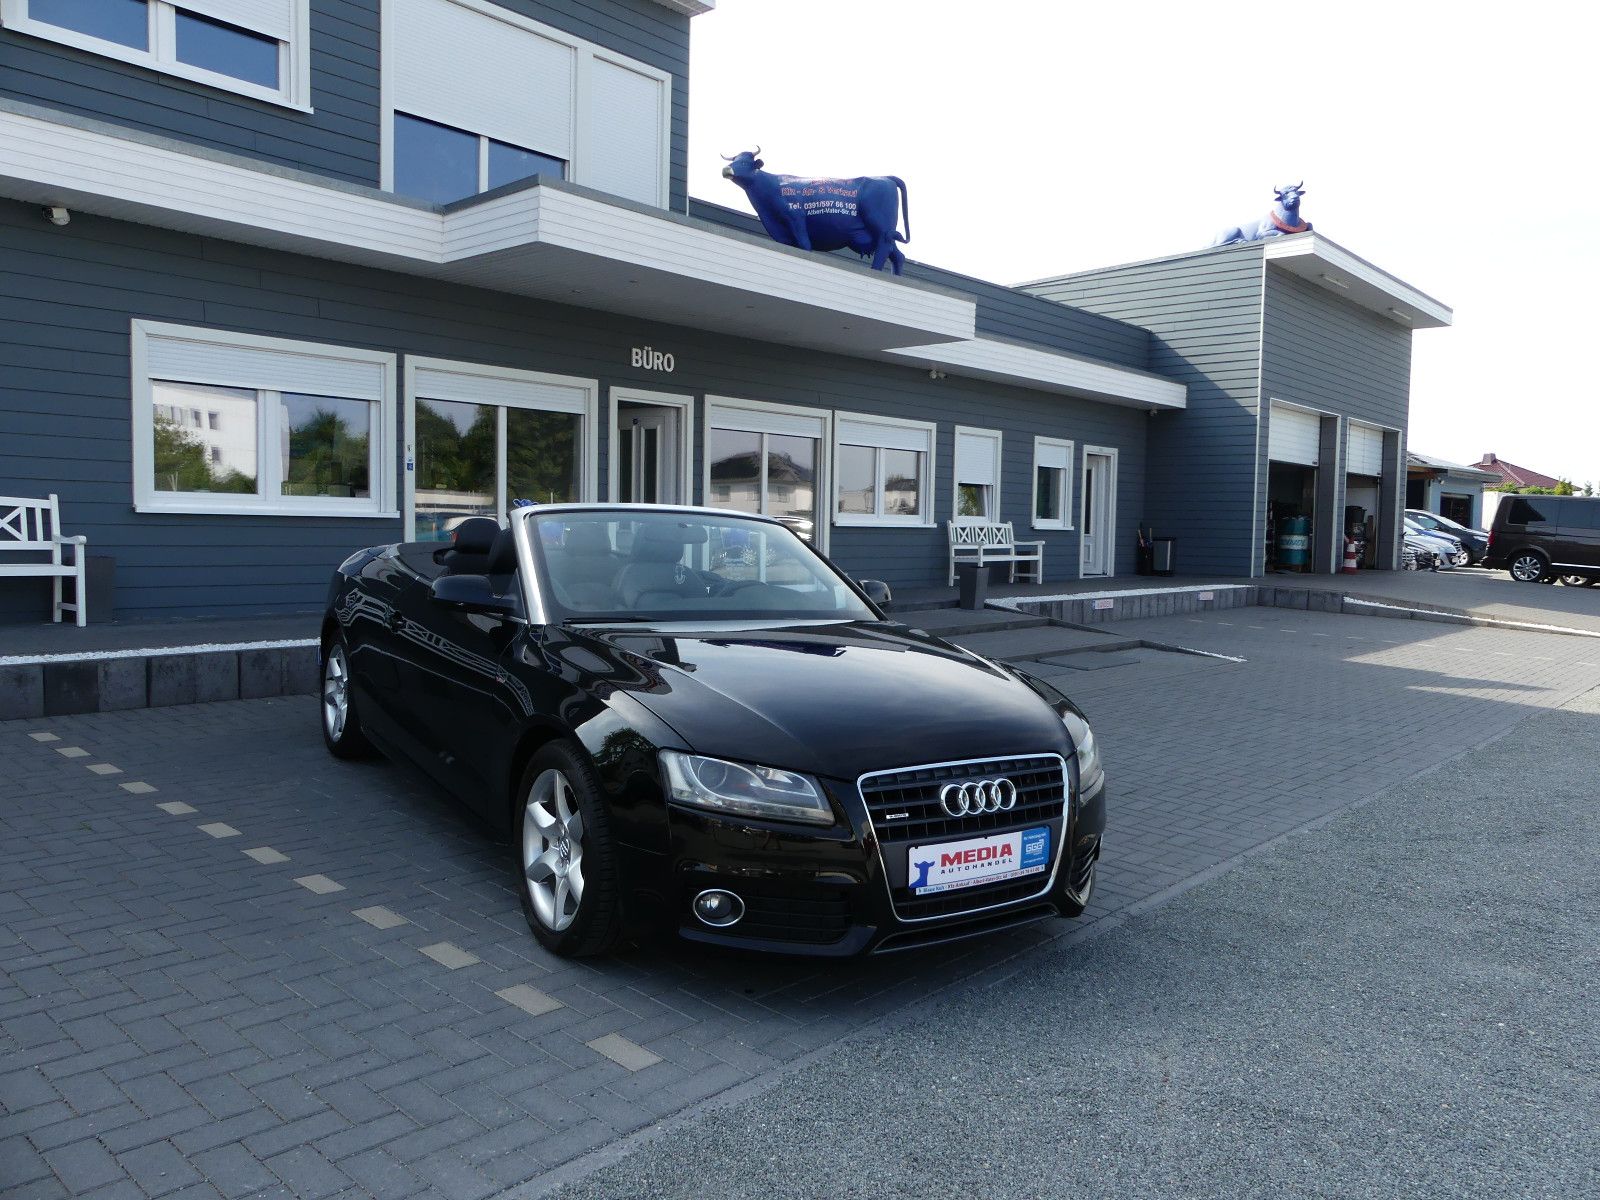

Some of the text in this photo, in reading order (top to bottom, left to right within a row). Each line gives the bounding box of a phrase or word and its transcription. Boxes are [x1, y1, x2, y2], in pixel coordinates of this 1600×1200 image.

[631, 346, 675, 373] BÜRO
[940, 843, 1013, 868] MEDIA
[940, 857, 1013, 875] AUTOHANDEL
